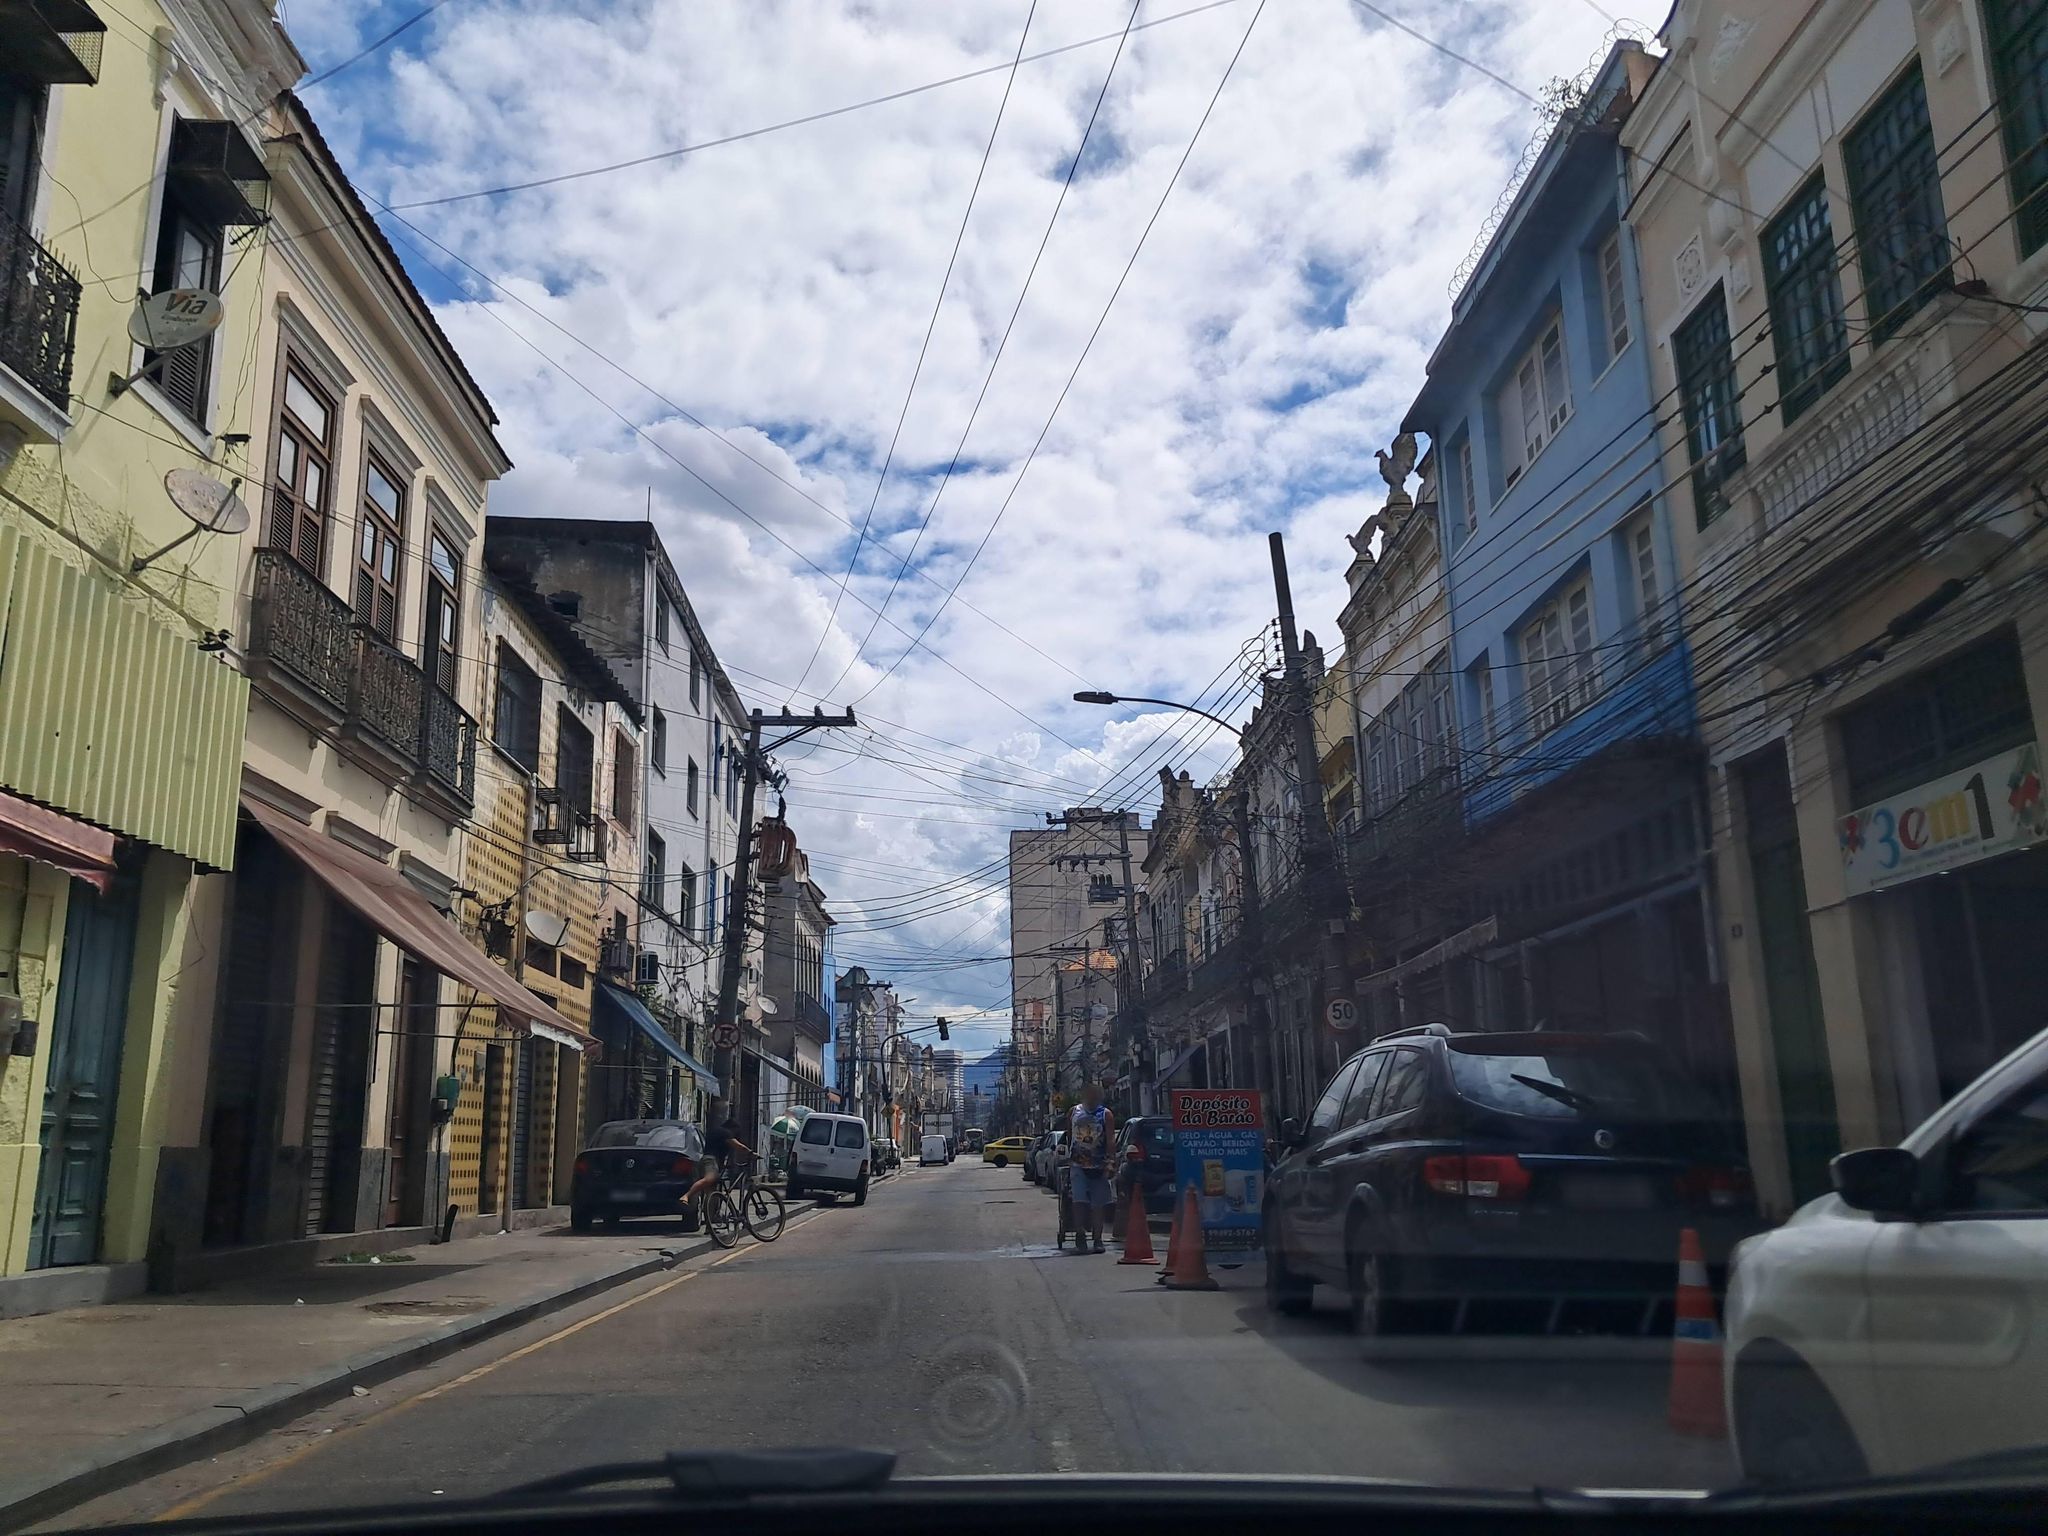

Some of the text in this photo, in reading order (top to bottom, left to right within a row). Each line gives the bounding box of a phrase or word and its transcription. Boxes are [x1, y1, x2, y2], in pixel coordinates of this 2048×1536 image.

[165, 293, 208, 314] Via
[1332, 1003, 1353, 1020] 50
[1180, 1095, 1250, 1112] Depósito
[1181, 1109, 1255, 1127] da Barão
[1198, 1148, 1225, 1156] MUITO
[1227, 1148, 1249, 1156] MAIS
